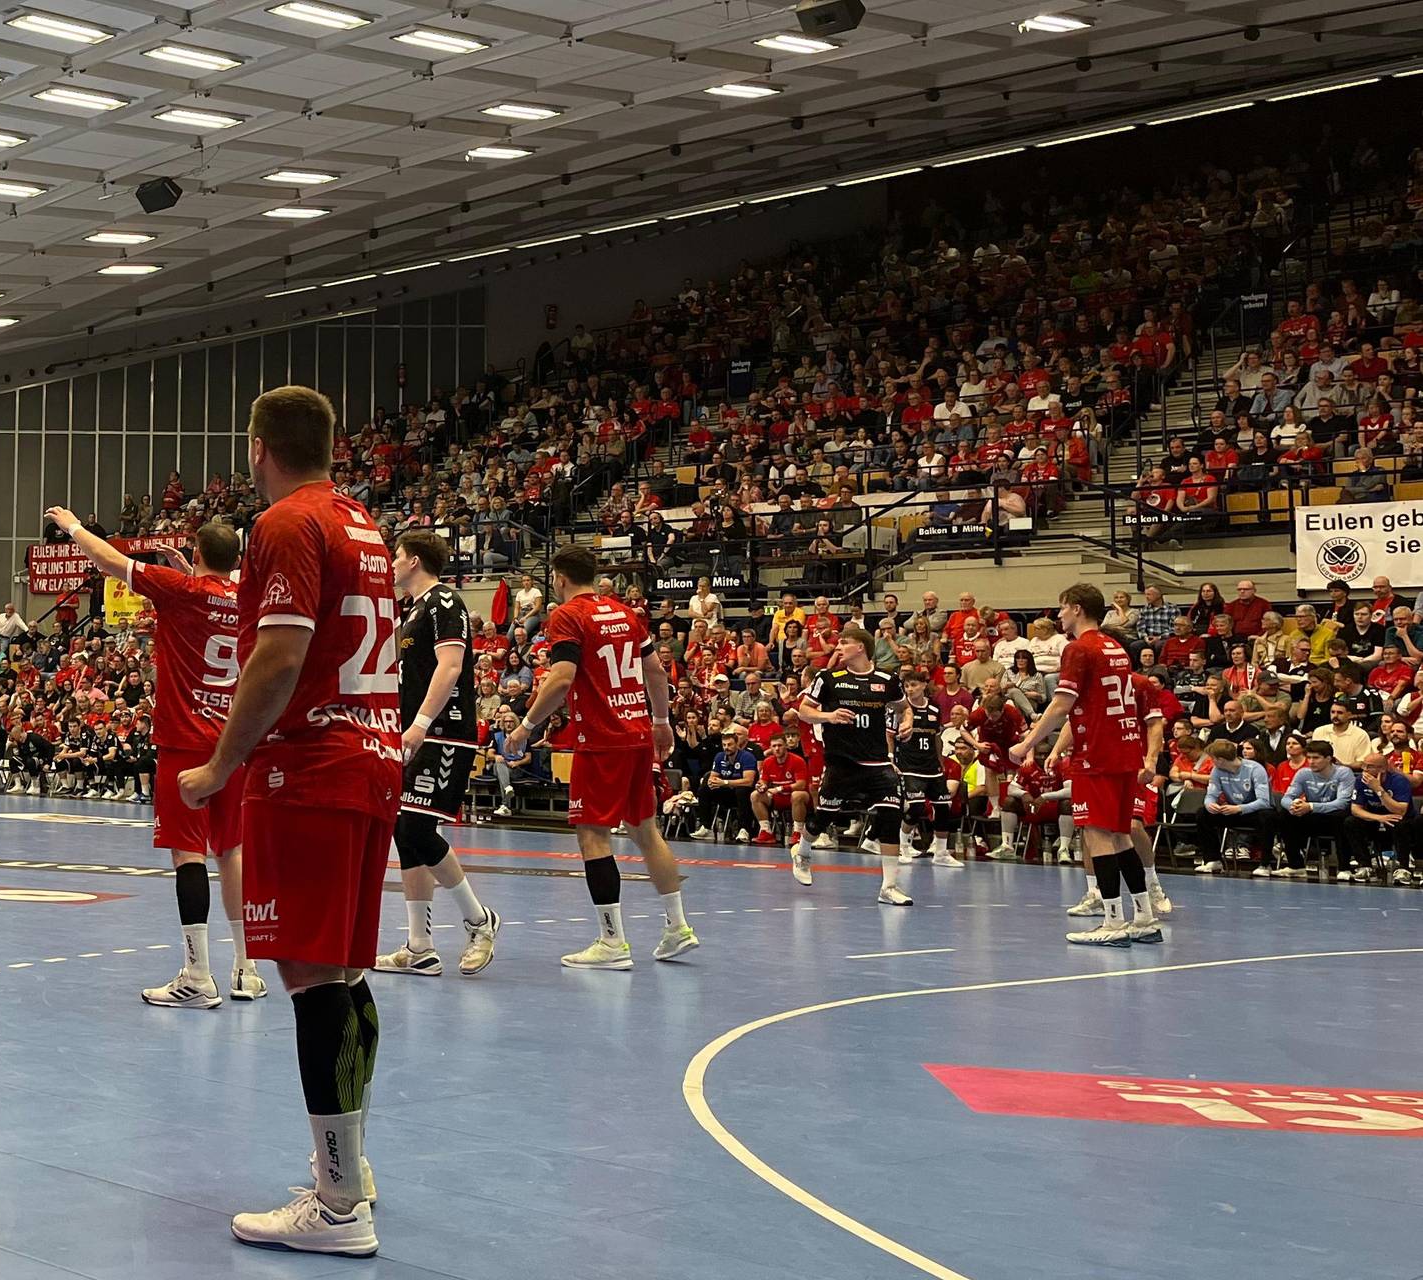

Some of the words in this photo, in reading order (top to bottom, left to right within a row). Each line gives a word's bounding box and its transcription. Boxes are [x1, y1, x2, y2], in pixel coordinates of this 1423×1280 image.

[1125, 514, 1158, 524] Bakon
[1306, 512, 1373, 531] Eulen
[918, 526, 948, 537] Balkon
[952, 526, 958, 534] B
[963, 524, 985, 534] Mitte
[1325, 539, 1356, 549] EULEN
[1386, 535, 1421, 554] sie
[48, 561, 64, 575] UNS
[65, 561, 77, 573] DIE
[367, 554, 388, 576] LOTTO
[656, 577, 693, 589] Balkon
[712, 576, 741, 589] Mitte
[608, 623, 631, 636] LOTTO
[339, 595, 399, 695] 22
[201, 633, 240, 688] 9
[596, 641, 644, 690] 14
[834, 682, 860, 693] Allbau
[1100, 673, 1137, 717] 34
[855, 713, 870, 729] 10
[918, 737, 930, 752] 15
[1072, 802, 1089, 813] twl
[244, 898, 279, 922] twl
[245, 934, 270, 943] CRAFT
[1118, 1092, 1423, 1131] CL
[325, 1130, 341, 1169] CRAFT
